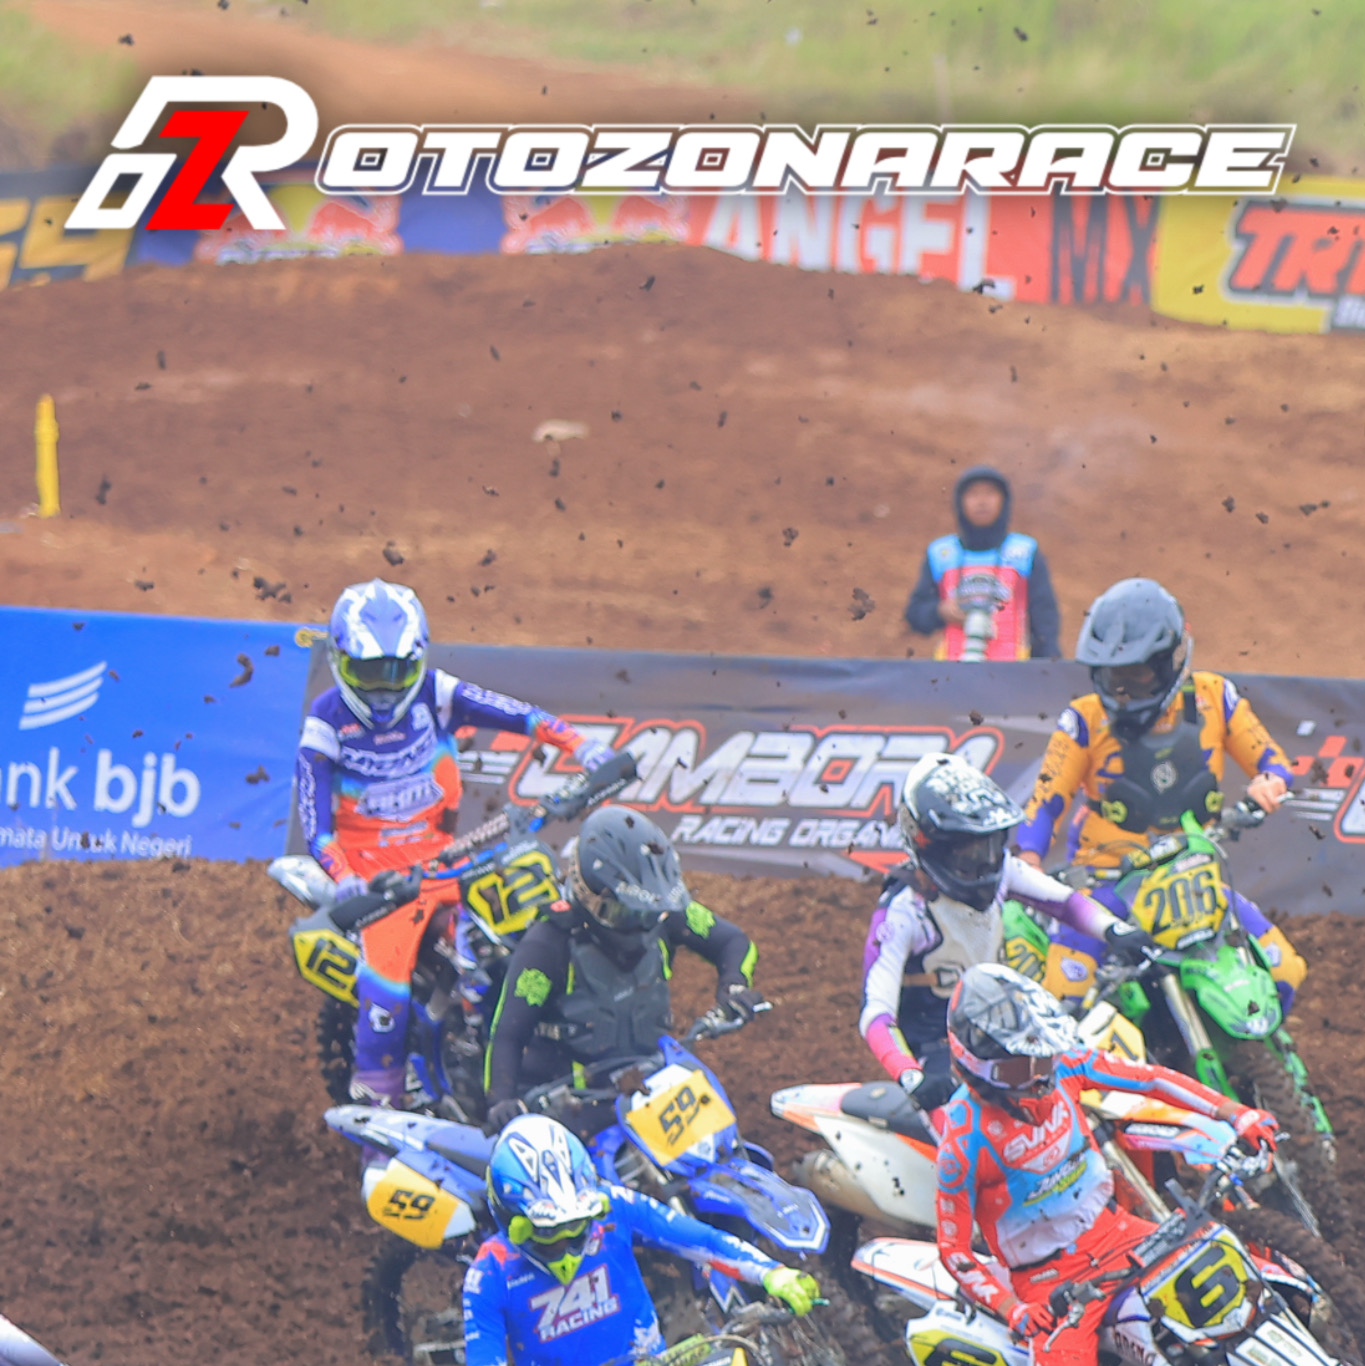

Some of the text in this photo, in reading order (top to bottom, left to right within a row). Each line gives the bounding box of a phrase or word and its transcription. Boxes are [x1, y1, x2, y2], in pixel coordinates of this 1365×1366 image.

[1050, 188, 1160, 306] MX
[93, 748, 202, 829] bjb
[672, 814, 785, 847] RACING
[1143, 870, 1222, 938] 206
[658, 1086, 700, 1147] 59
[383, 1189, 436, 1221] 59
[530, 1264, 613, 1332] 741
[541, 1297, 620, 1342] RACING
[1174, 1243, 1242, 1329] 6
